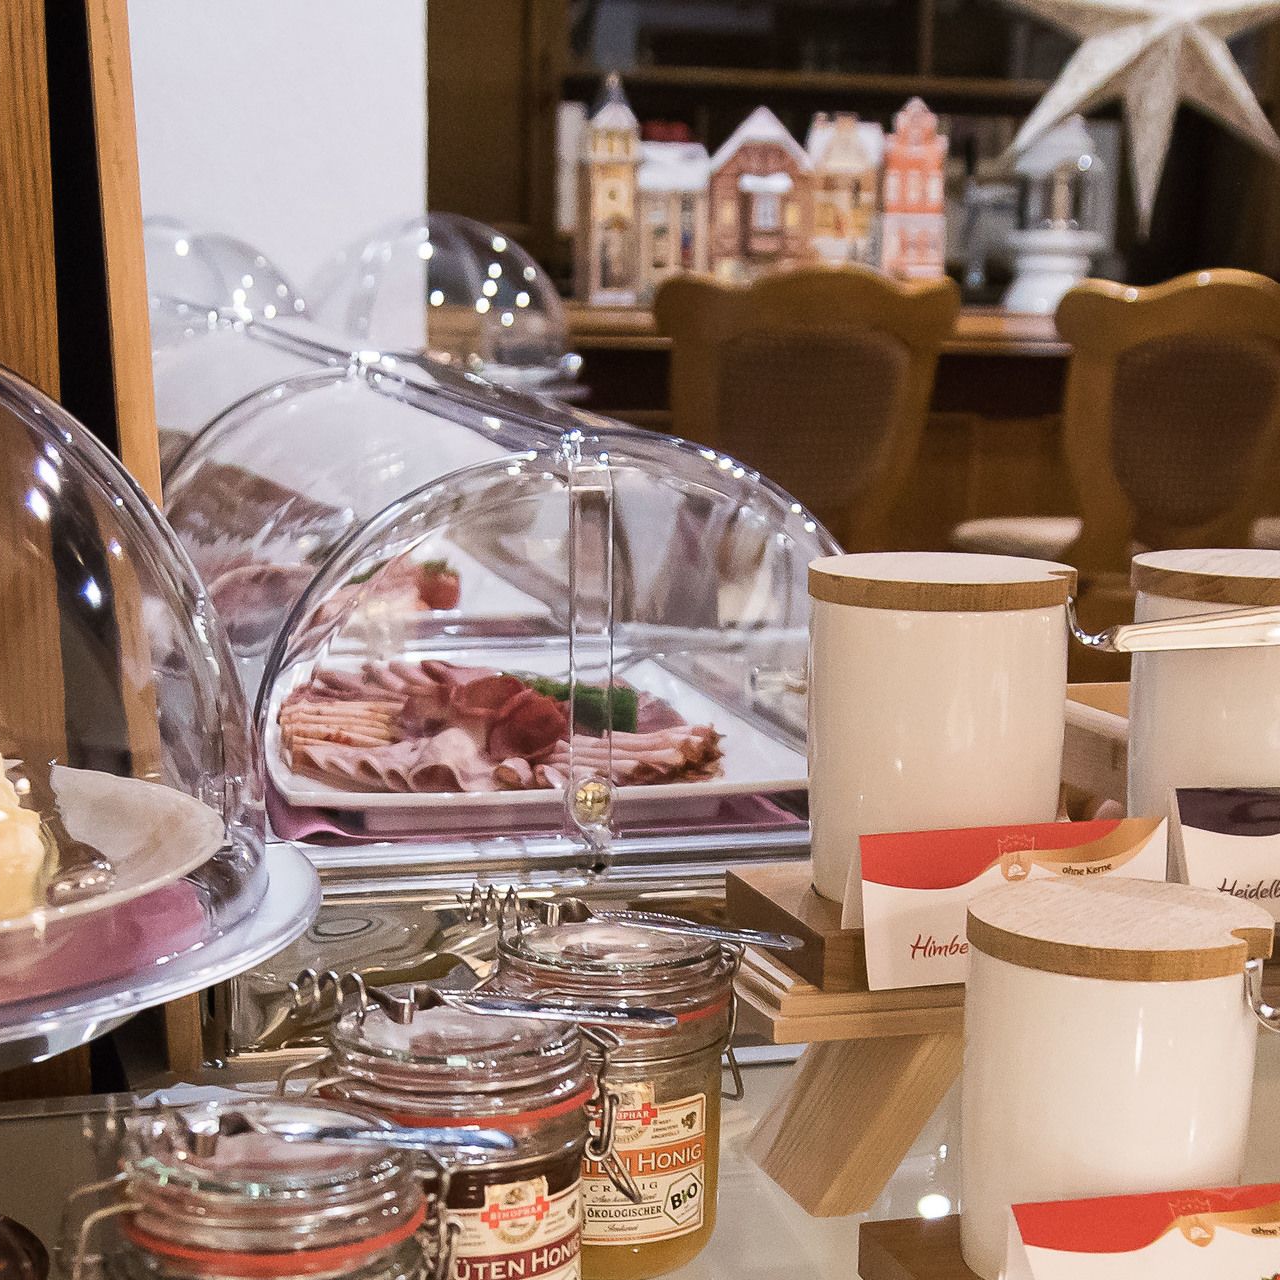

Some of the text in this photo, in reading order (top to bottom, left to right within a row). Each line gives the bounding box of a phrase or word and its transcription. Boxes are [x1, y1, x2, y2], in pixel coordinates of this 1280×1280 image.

[1062, 862, 1112, 876] ohne Kerne
[638, 1143, 701, 1172] HONIG
[587, 1204, 661, 1219] ÖKOLOGISCHER
[1251, 1226, 1278, 1237] ohne
